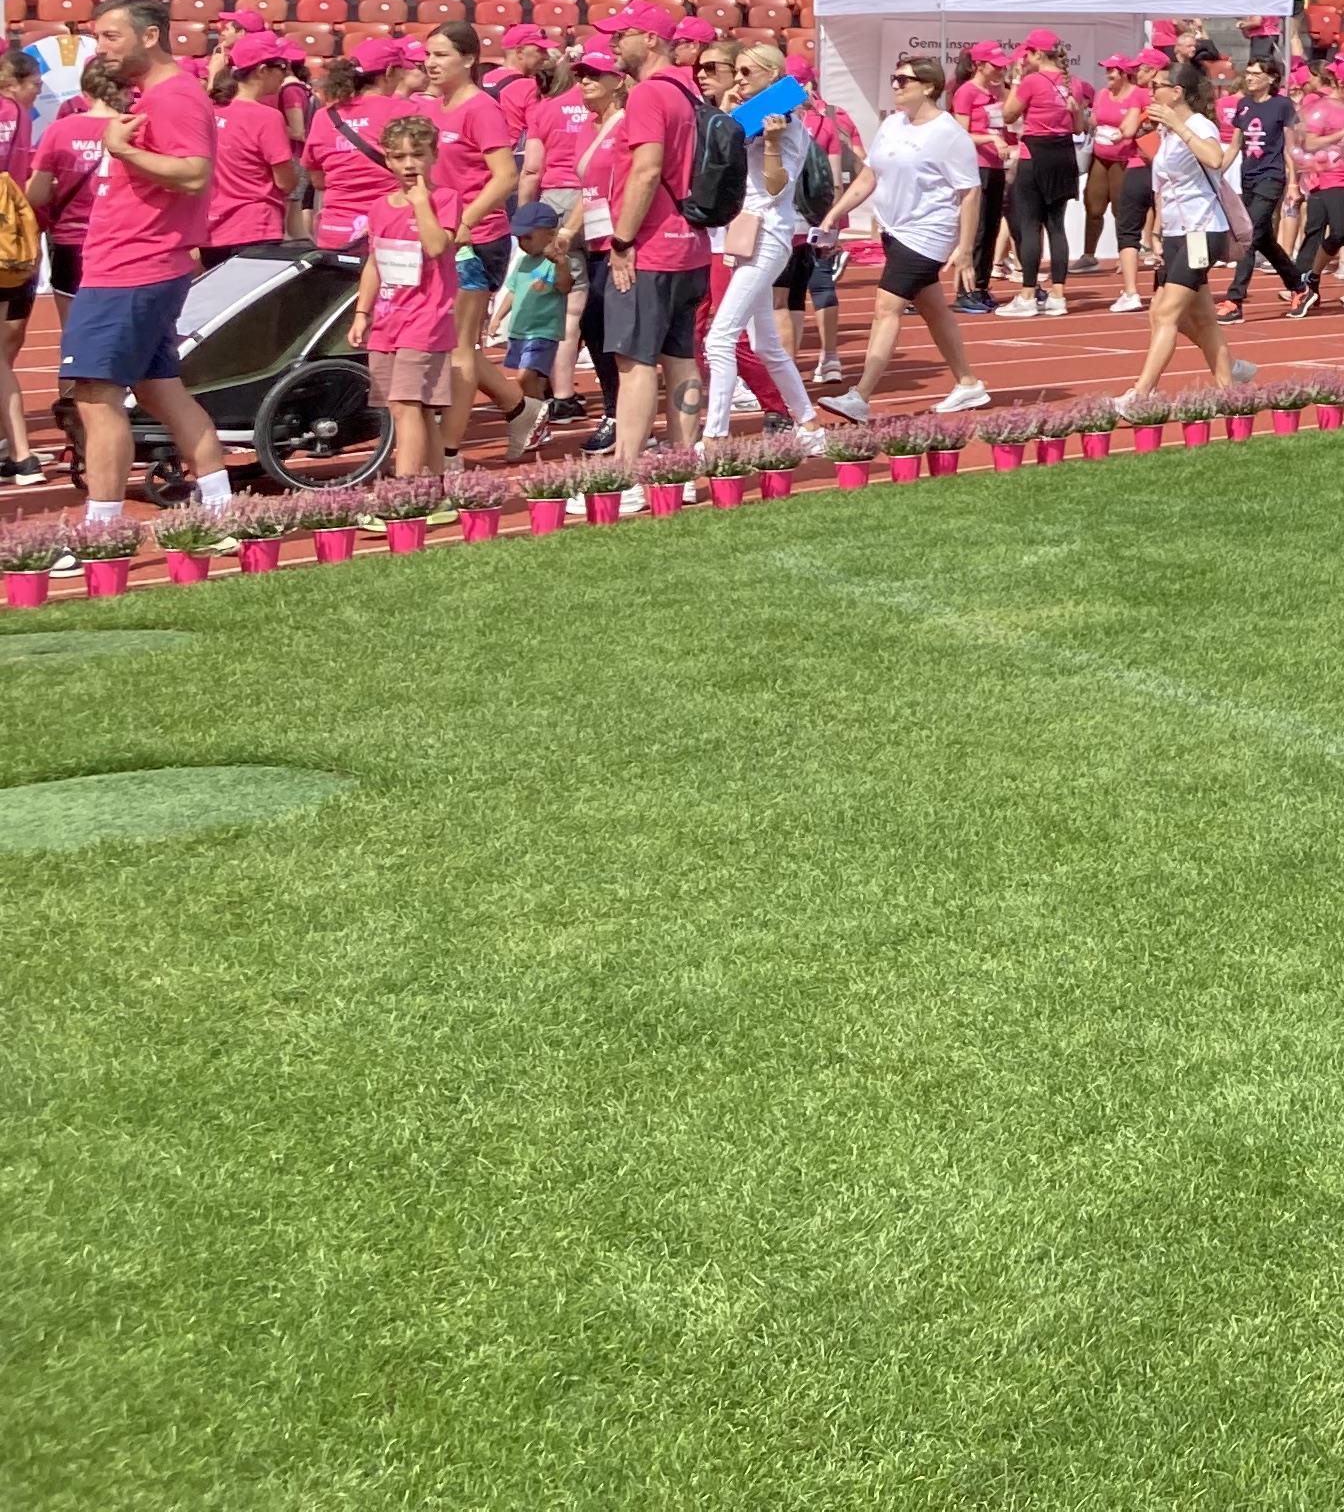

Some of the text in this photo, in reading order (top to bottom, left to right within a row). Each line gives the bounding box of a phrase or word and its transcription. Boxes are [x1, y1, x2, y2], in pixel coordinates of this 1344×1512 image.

[561, 105, 589, 114] WAL
[571, 113, 588, 123] OF
[71, 139, 102, 150] WAL
[82, 150, 102, 161] OF
